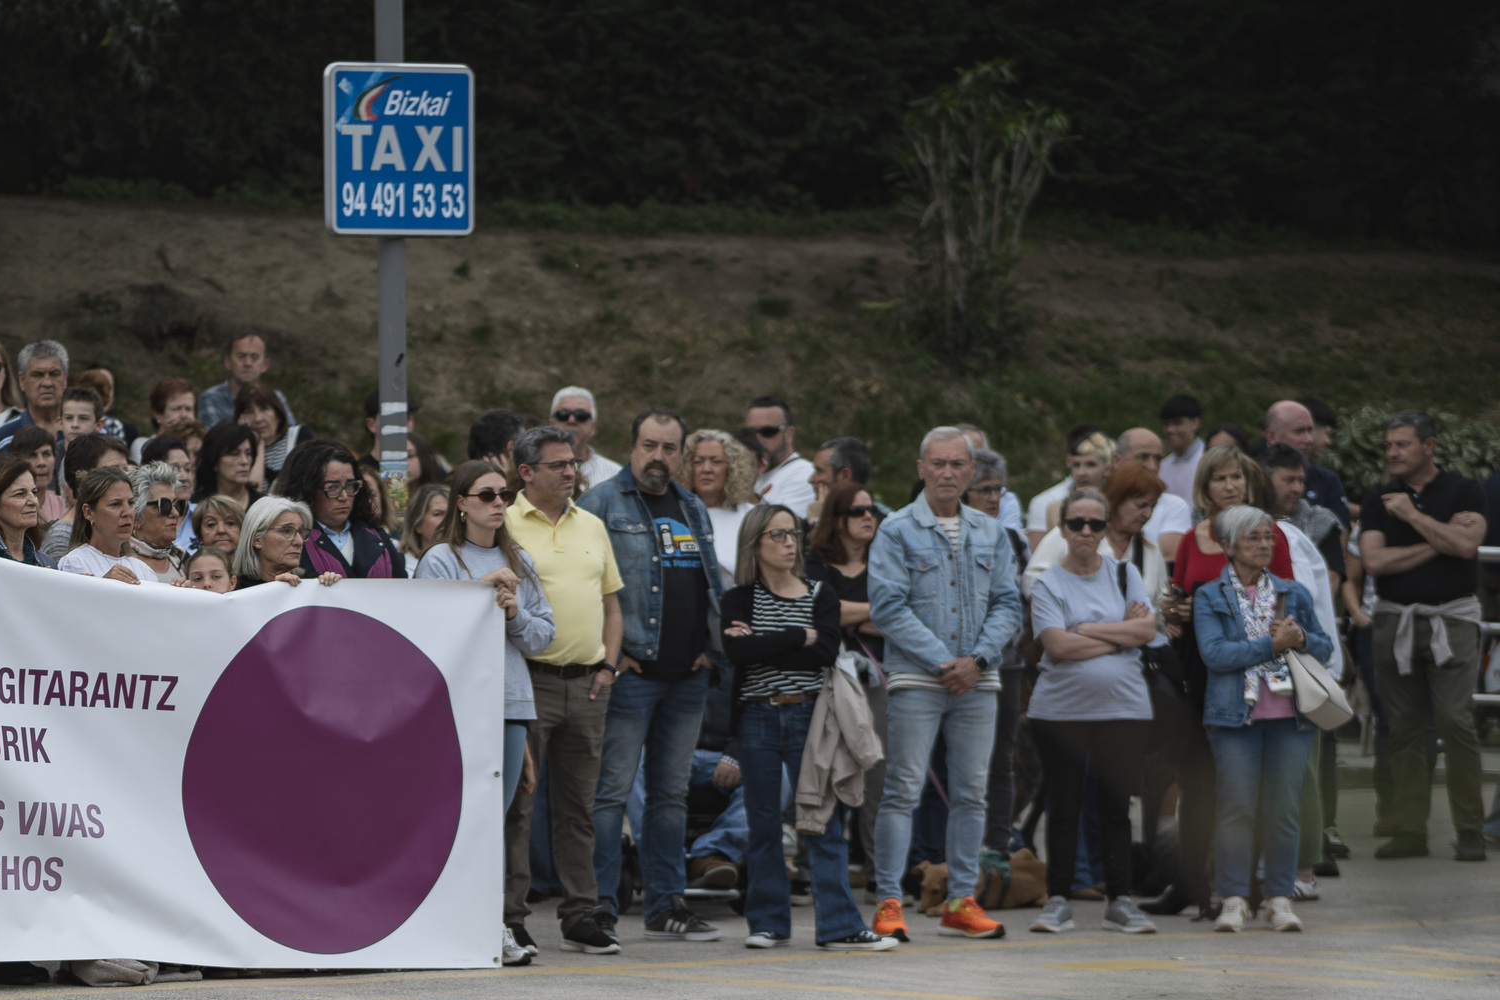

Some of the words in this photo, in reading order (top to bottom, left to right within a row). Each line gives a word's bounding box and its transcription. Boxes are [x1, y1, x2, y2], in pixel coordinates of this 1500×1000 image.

[384, 90, 452, 117] Bizkai
[341, 124, 464, 172] TAXI
[342, 181, 367, 217] 94
[371, 182, 405, 218] 491
[412, 183, 436, 218] 53
[441, 183, 465, 218] 53
[18, 800, 106, 838] VIVAS
